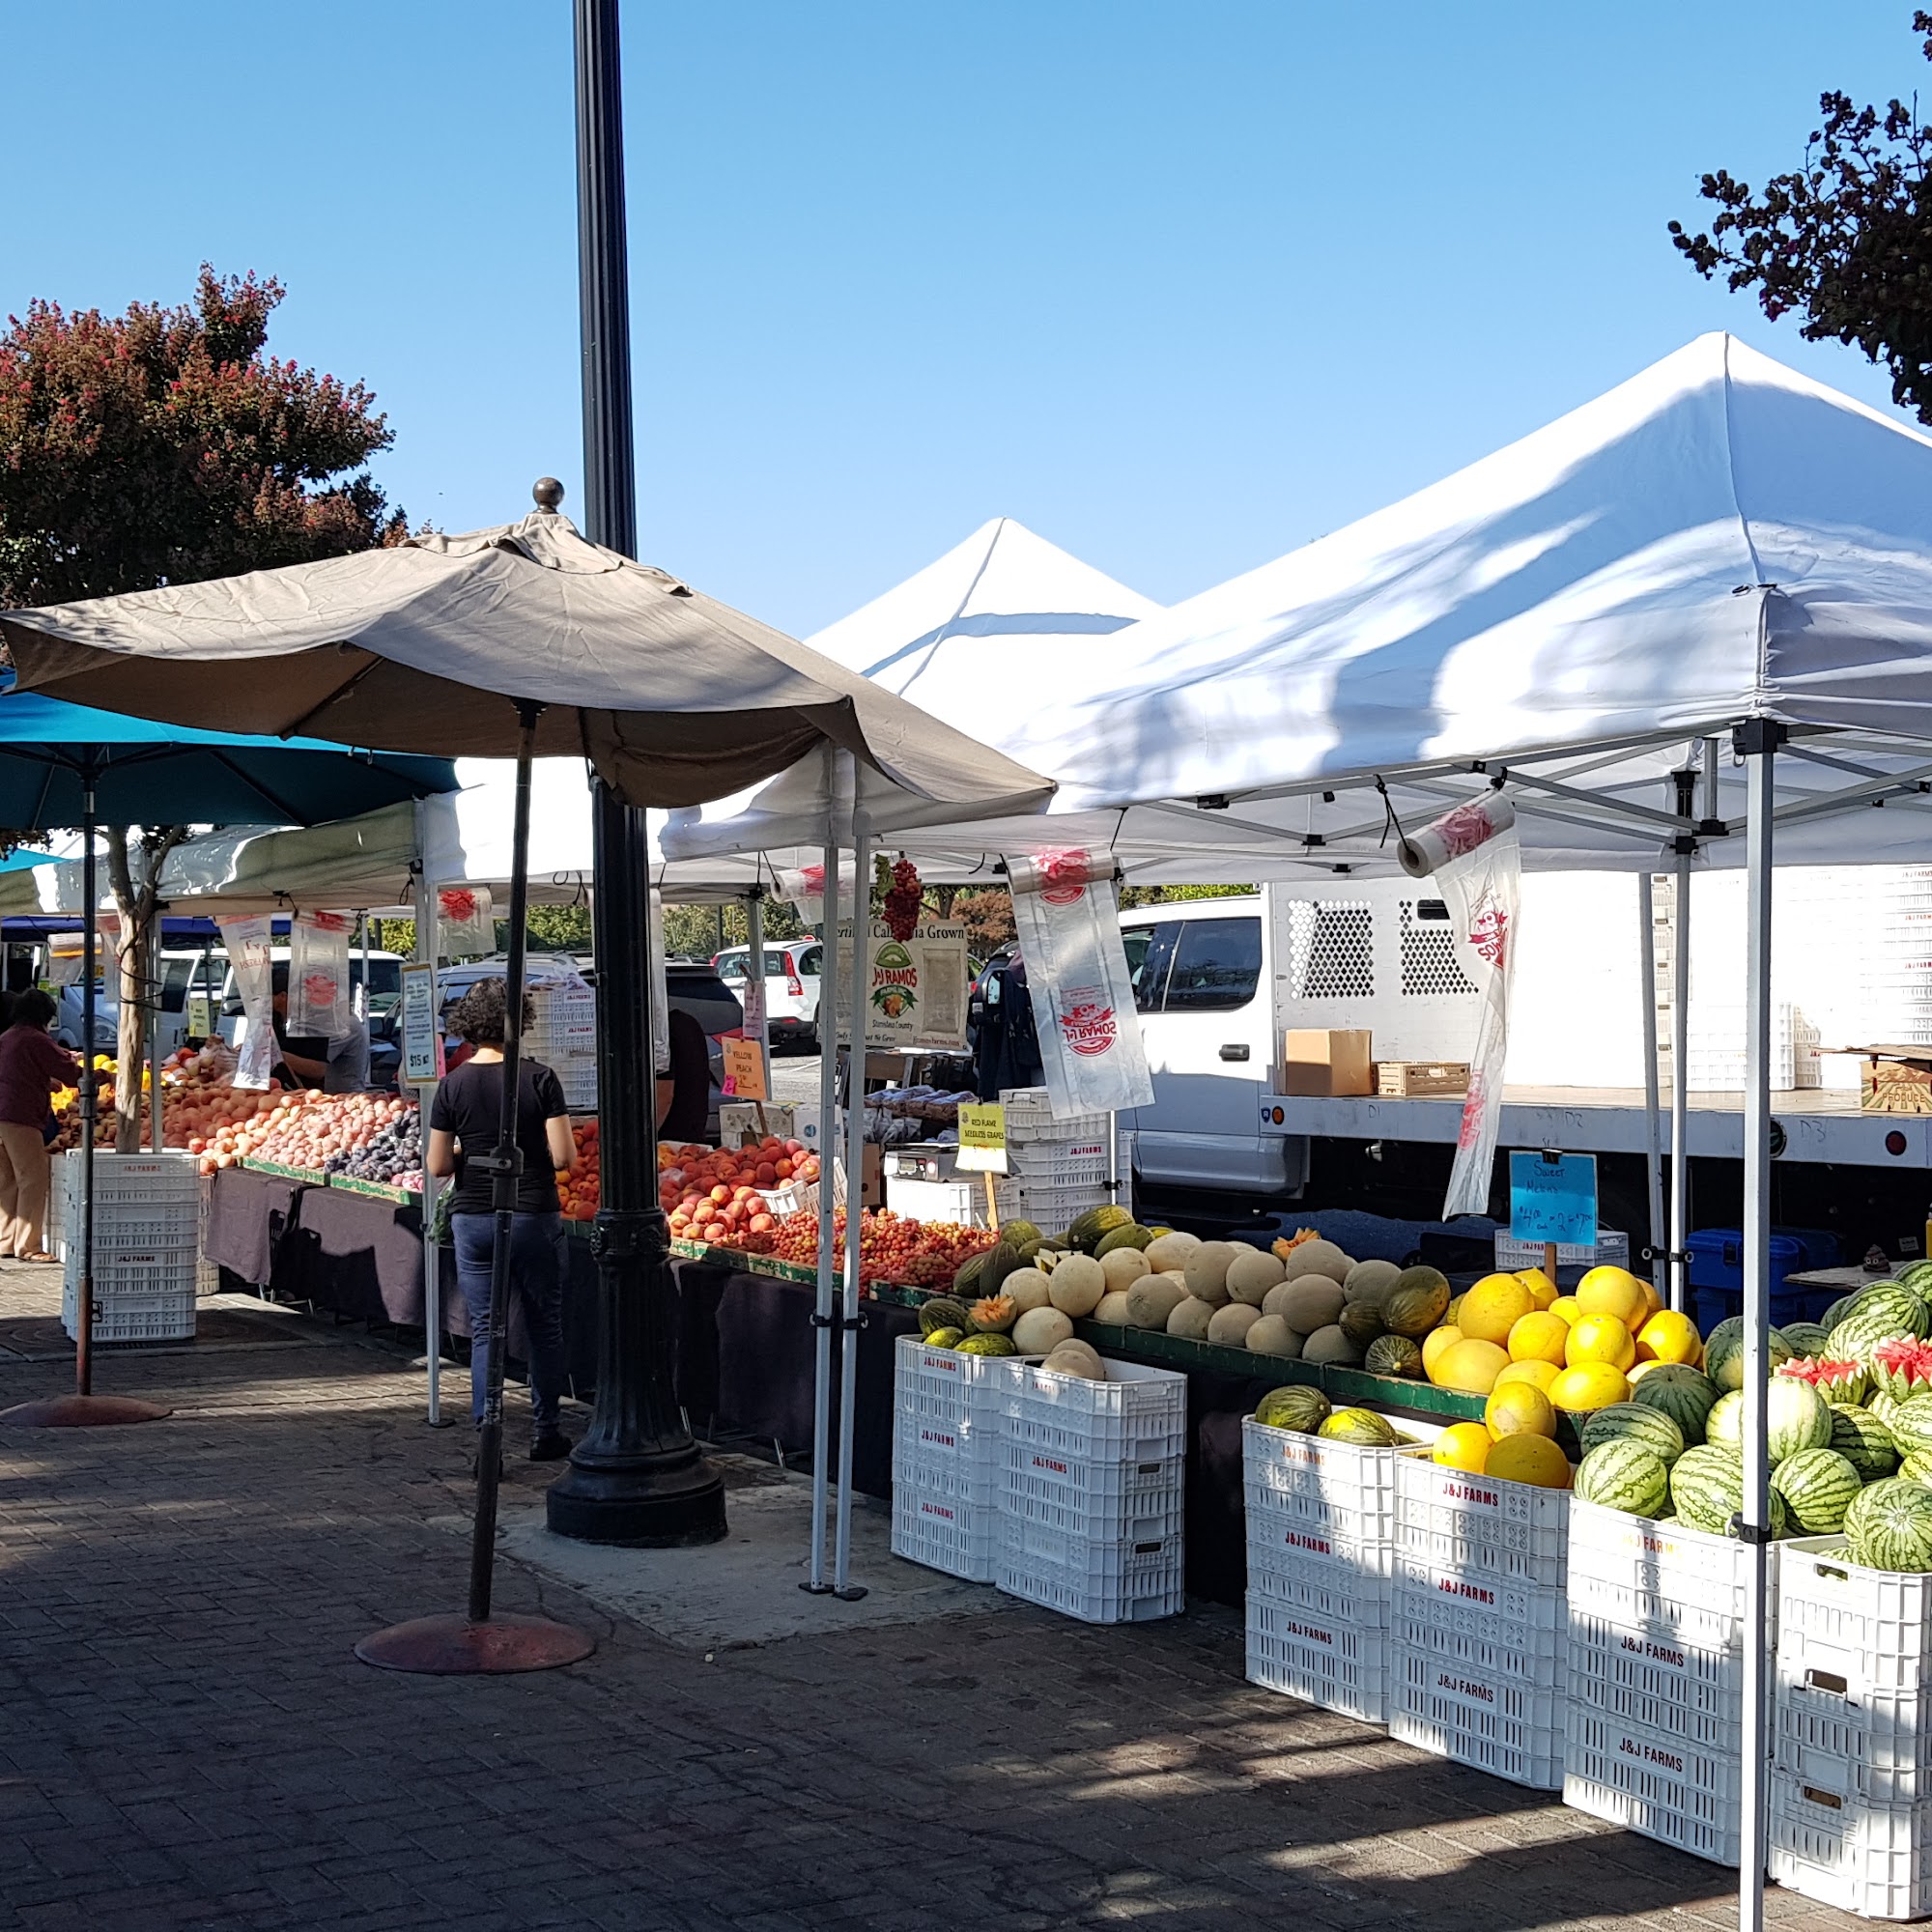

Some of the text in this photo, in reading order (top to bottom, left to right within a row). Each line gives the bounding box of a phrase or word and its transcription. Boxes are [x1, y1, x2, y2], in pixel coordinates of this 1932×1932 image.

[927, 924, 964, 939] Grown
[885, 967, 918, 987] RAMOS
[410, 1054, 421, 1067] $15
[1883, 1093, 1926, 1103] PRODUCE
[1801, 1121, 1826, 1142] D3
[1070, 1146, 1101, 1155] J&J FARMS
[1534, 1242, 1546, 1251] FAR
[923, 1356, 956, 1372] J&J FARMS
[922, 1429, 954, 1447] J&J FARMS
[1032, 1455, 1067, 1474] J&J FARMS
[1282, 1444, 1325, 1466] J&J FARMS
[1443, 1482, 1498, 1507] J&J FARMS
[922, 1501, 954, 1520] J&J FARMS
[1285, 1531, 1331, 1555] J&J FARMS
[1437, 1577, 1495, 1605] J&J FARMS
[1287, 1620, 1333, 1645] J&J FARMS
[1621, 1634, 1685, 1668] J&J FARMS
[1437, 1673, 1493, 1703] J&J FARMS
[1619, 1737, 1683, 1773] J&J FARMS
